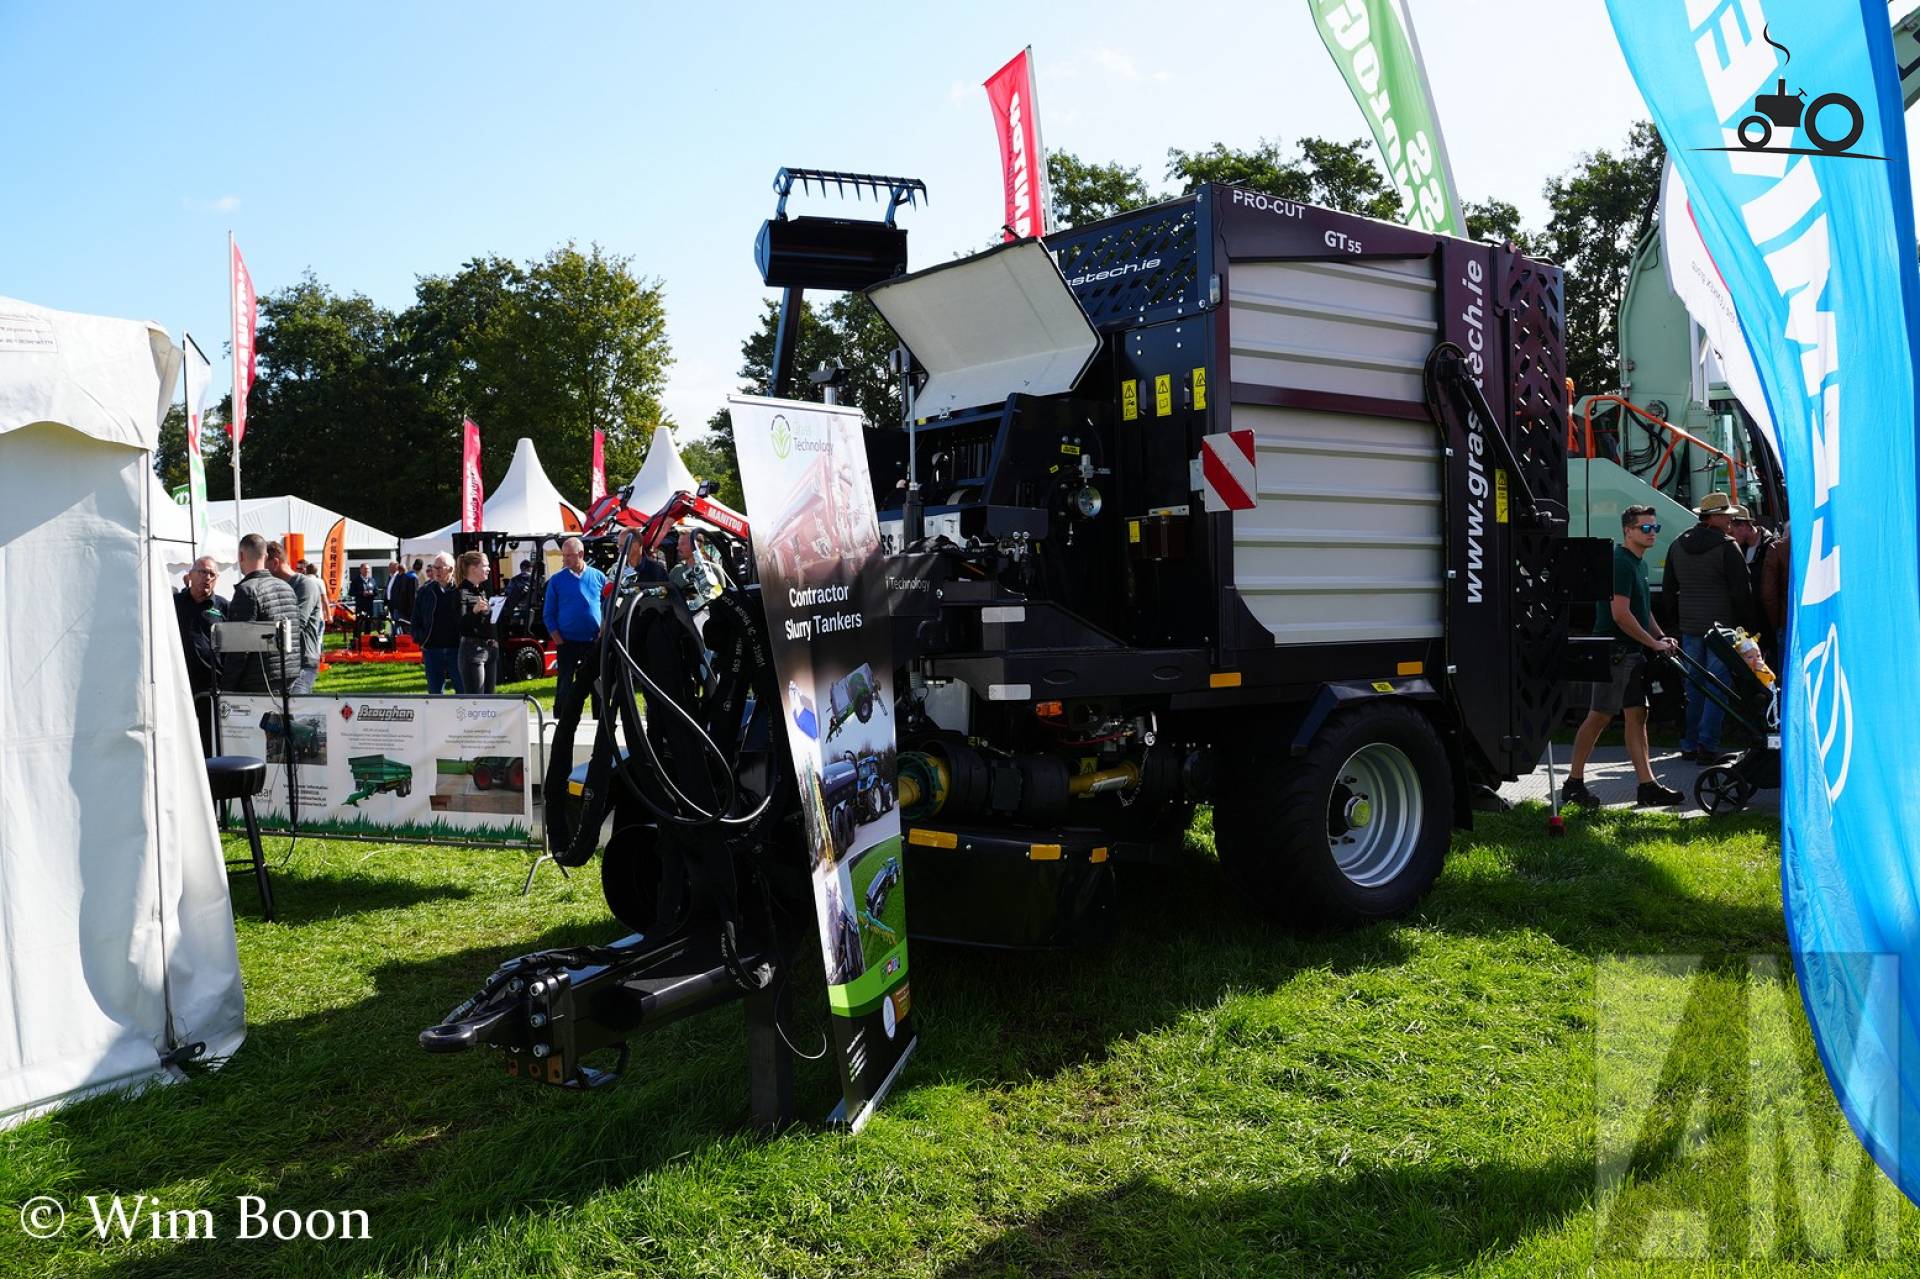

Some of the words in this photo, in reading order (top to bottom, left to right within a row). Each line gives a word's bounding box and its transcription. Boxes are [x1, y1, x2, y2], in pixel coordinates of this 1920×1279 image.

[1233, 189, 1306, 219] PRO-CUT
[1066, 258, 1161, 287] stech.ie
[1462, 258, 1489, 604] www.grastech.ie
[793, 436, 834, 457] Technology
[708, 506, 743, 532] MANITOU
[788, 584, 849, 608] Contractor
[784, 618, 812, 641] Slurry
[812, 611, 863, 634] Tankers
[358, 704, 415, 722] Broughan
